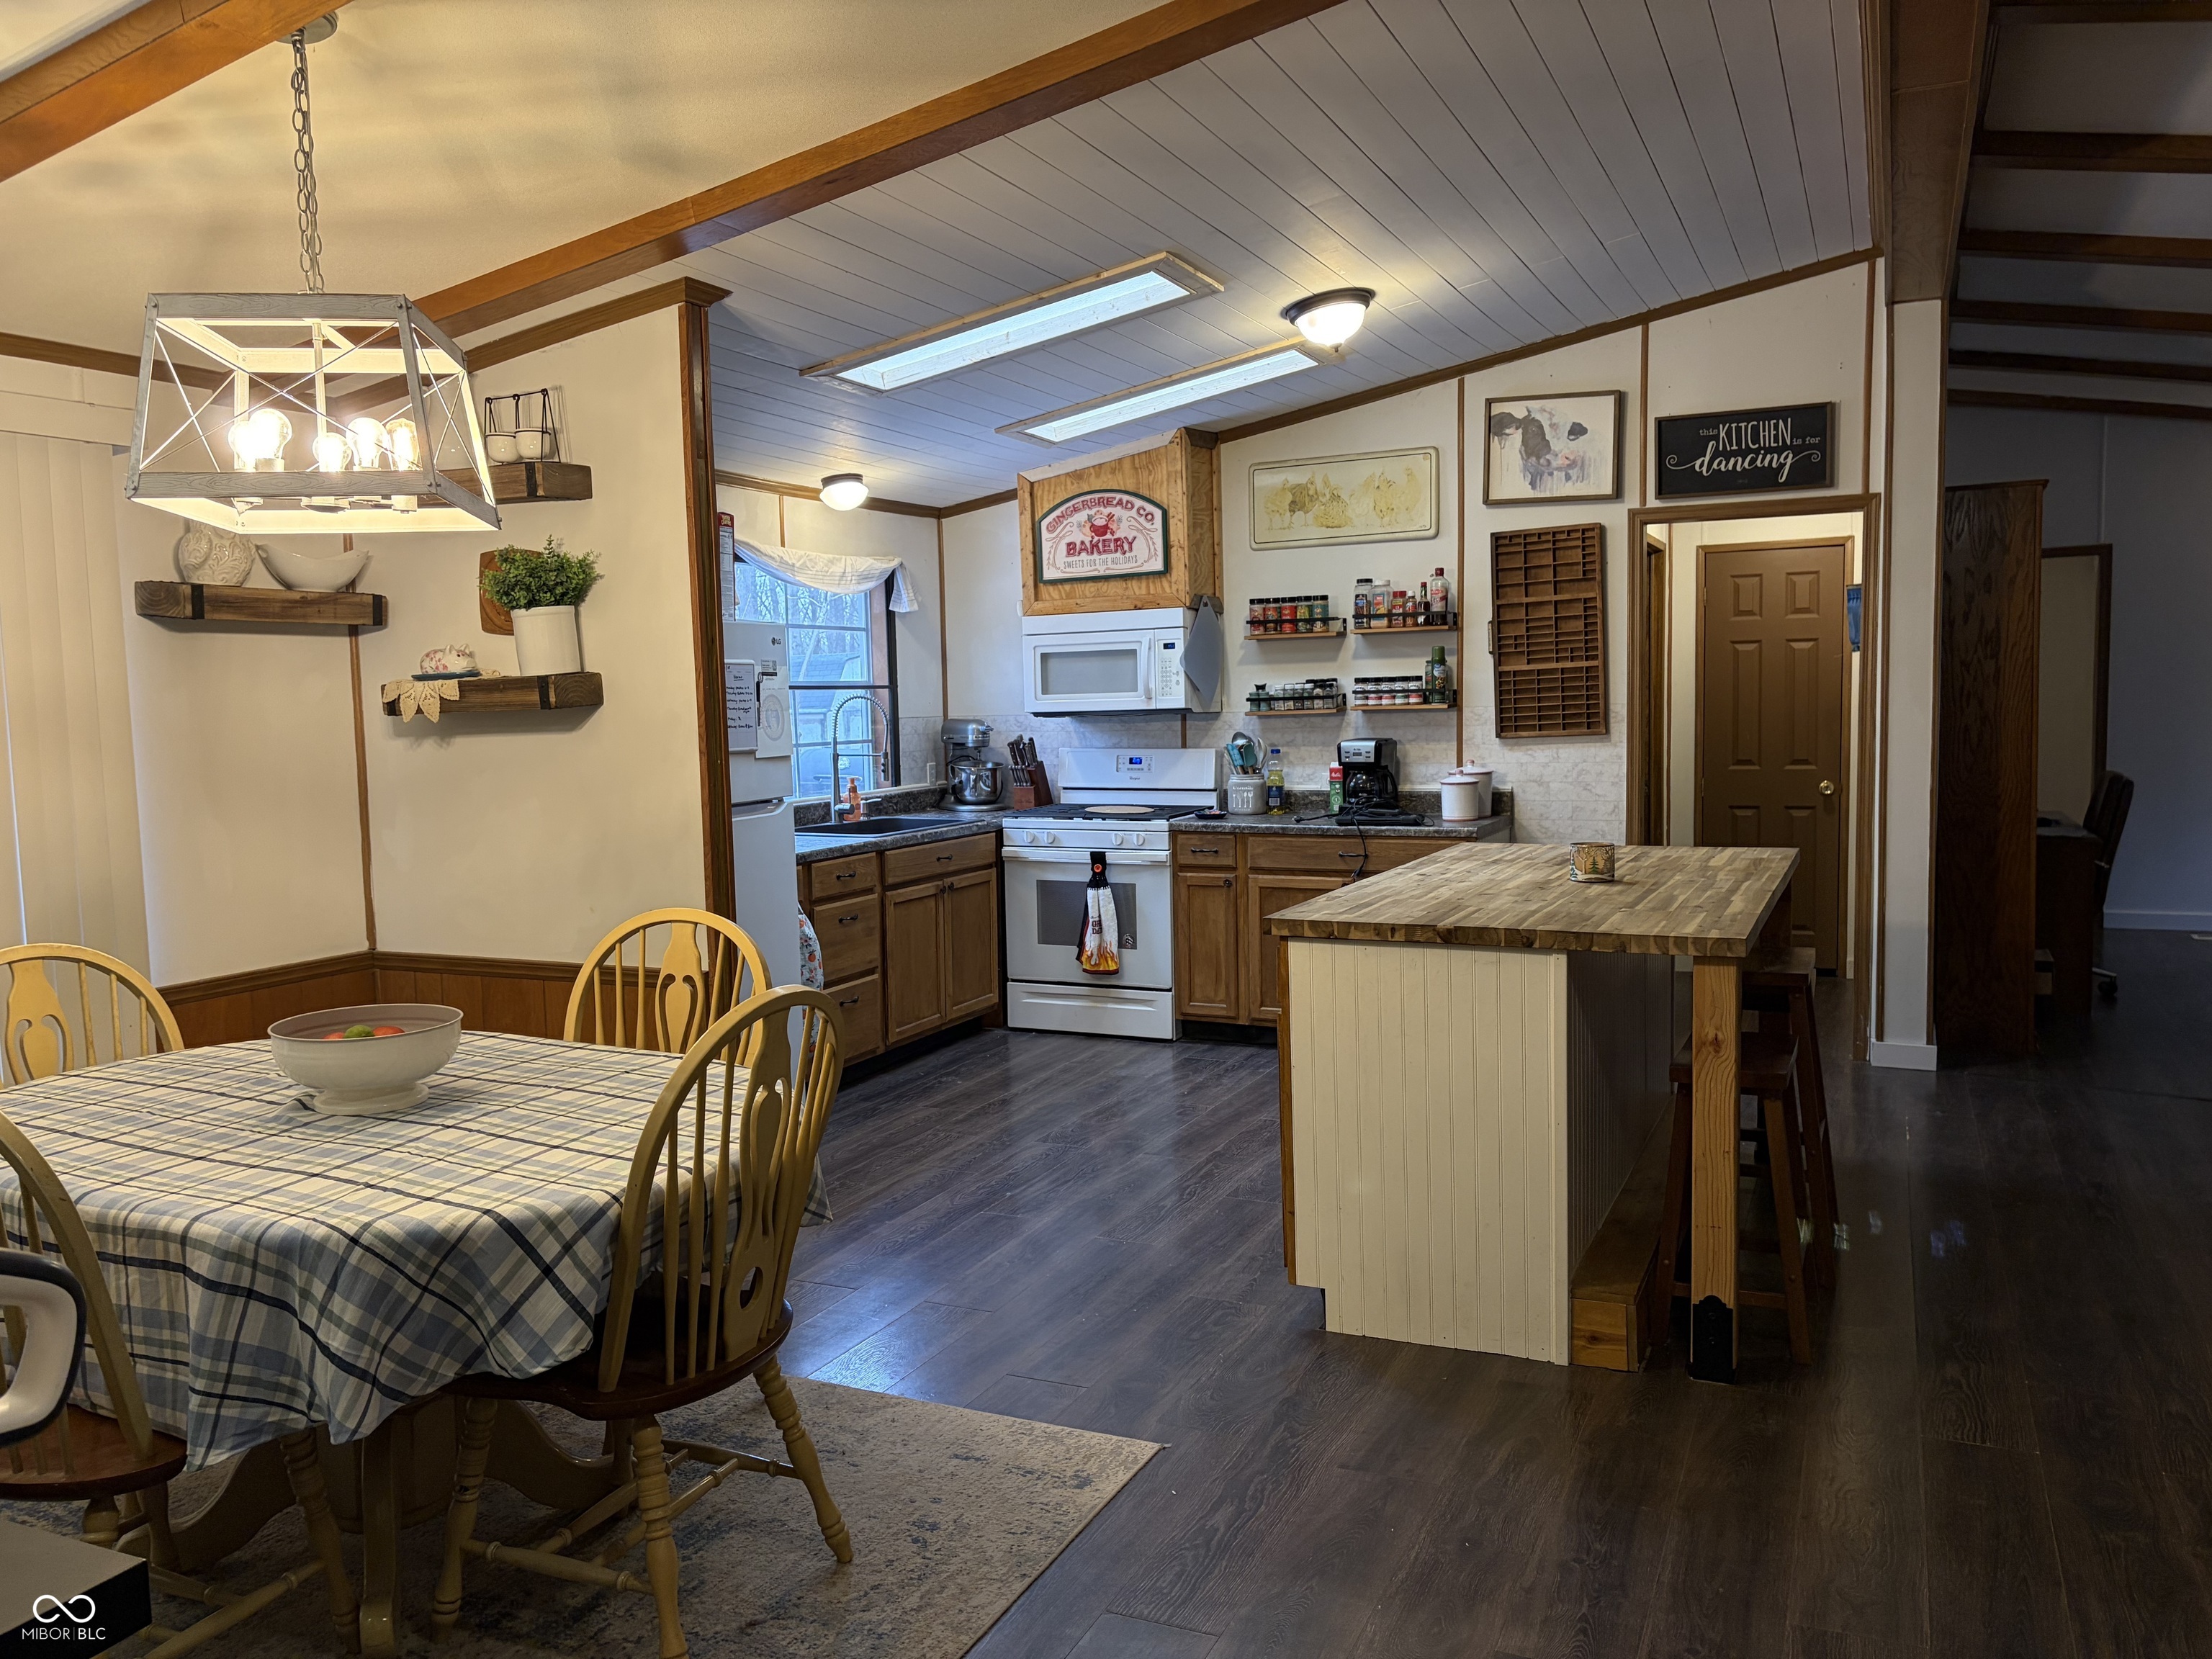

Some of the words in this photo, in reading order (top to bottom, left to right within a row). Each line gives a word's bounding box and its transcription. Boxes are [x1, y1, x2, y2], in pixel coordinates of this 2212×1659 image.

[1719, 418, 1791, 451] KITCHEN
[1792, 436, 1802, 445] is
[1805, 436, 1821, 444] for
[1694, 440, 1794, 483] dancing
[1046, 496, 1135, 534] GINGERBREAD
[1136, 505, 1156, 526] CO.
[1063, 560, 1085, 570] SWEETS
[1086, 559, 1097, 567] FOR
[1098, 557, 1109, 567] THE
[1110, 554, 1138, 565] HOLIDAYS
[1065, 536, 1137, 558] BAKERY
